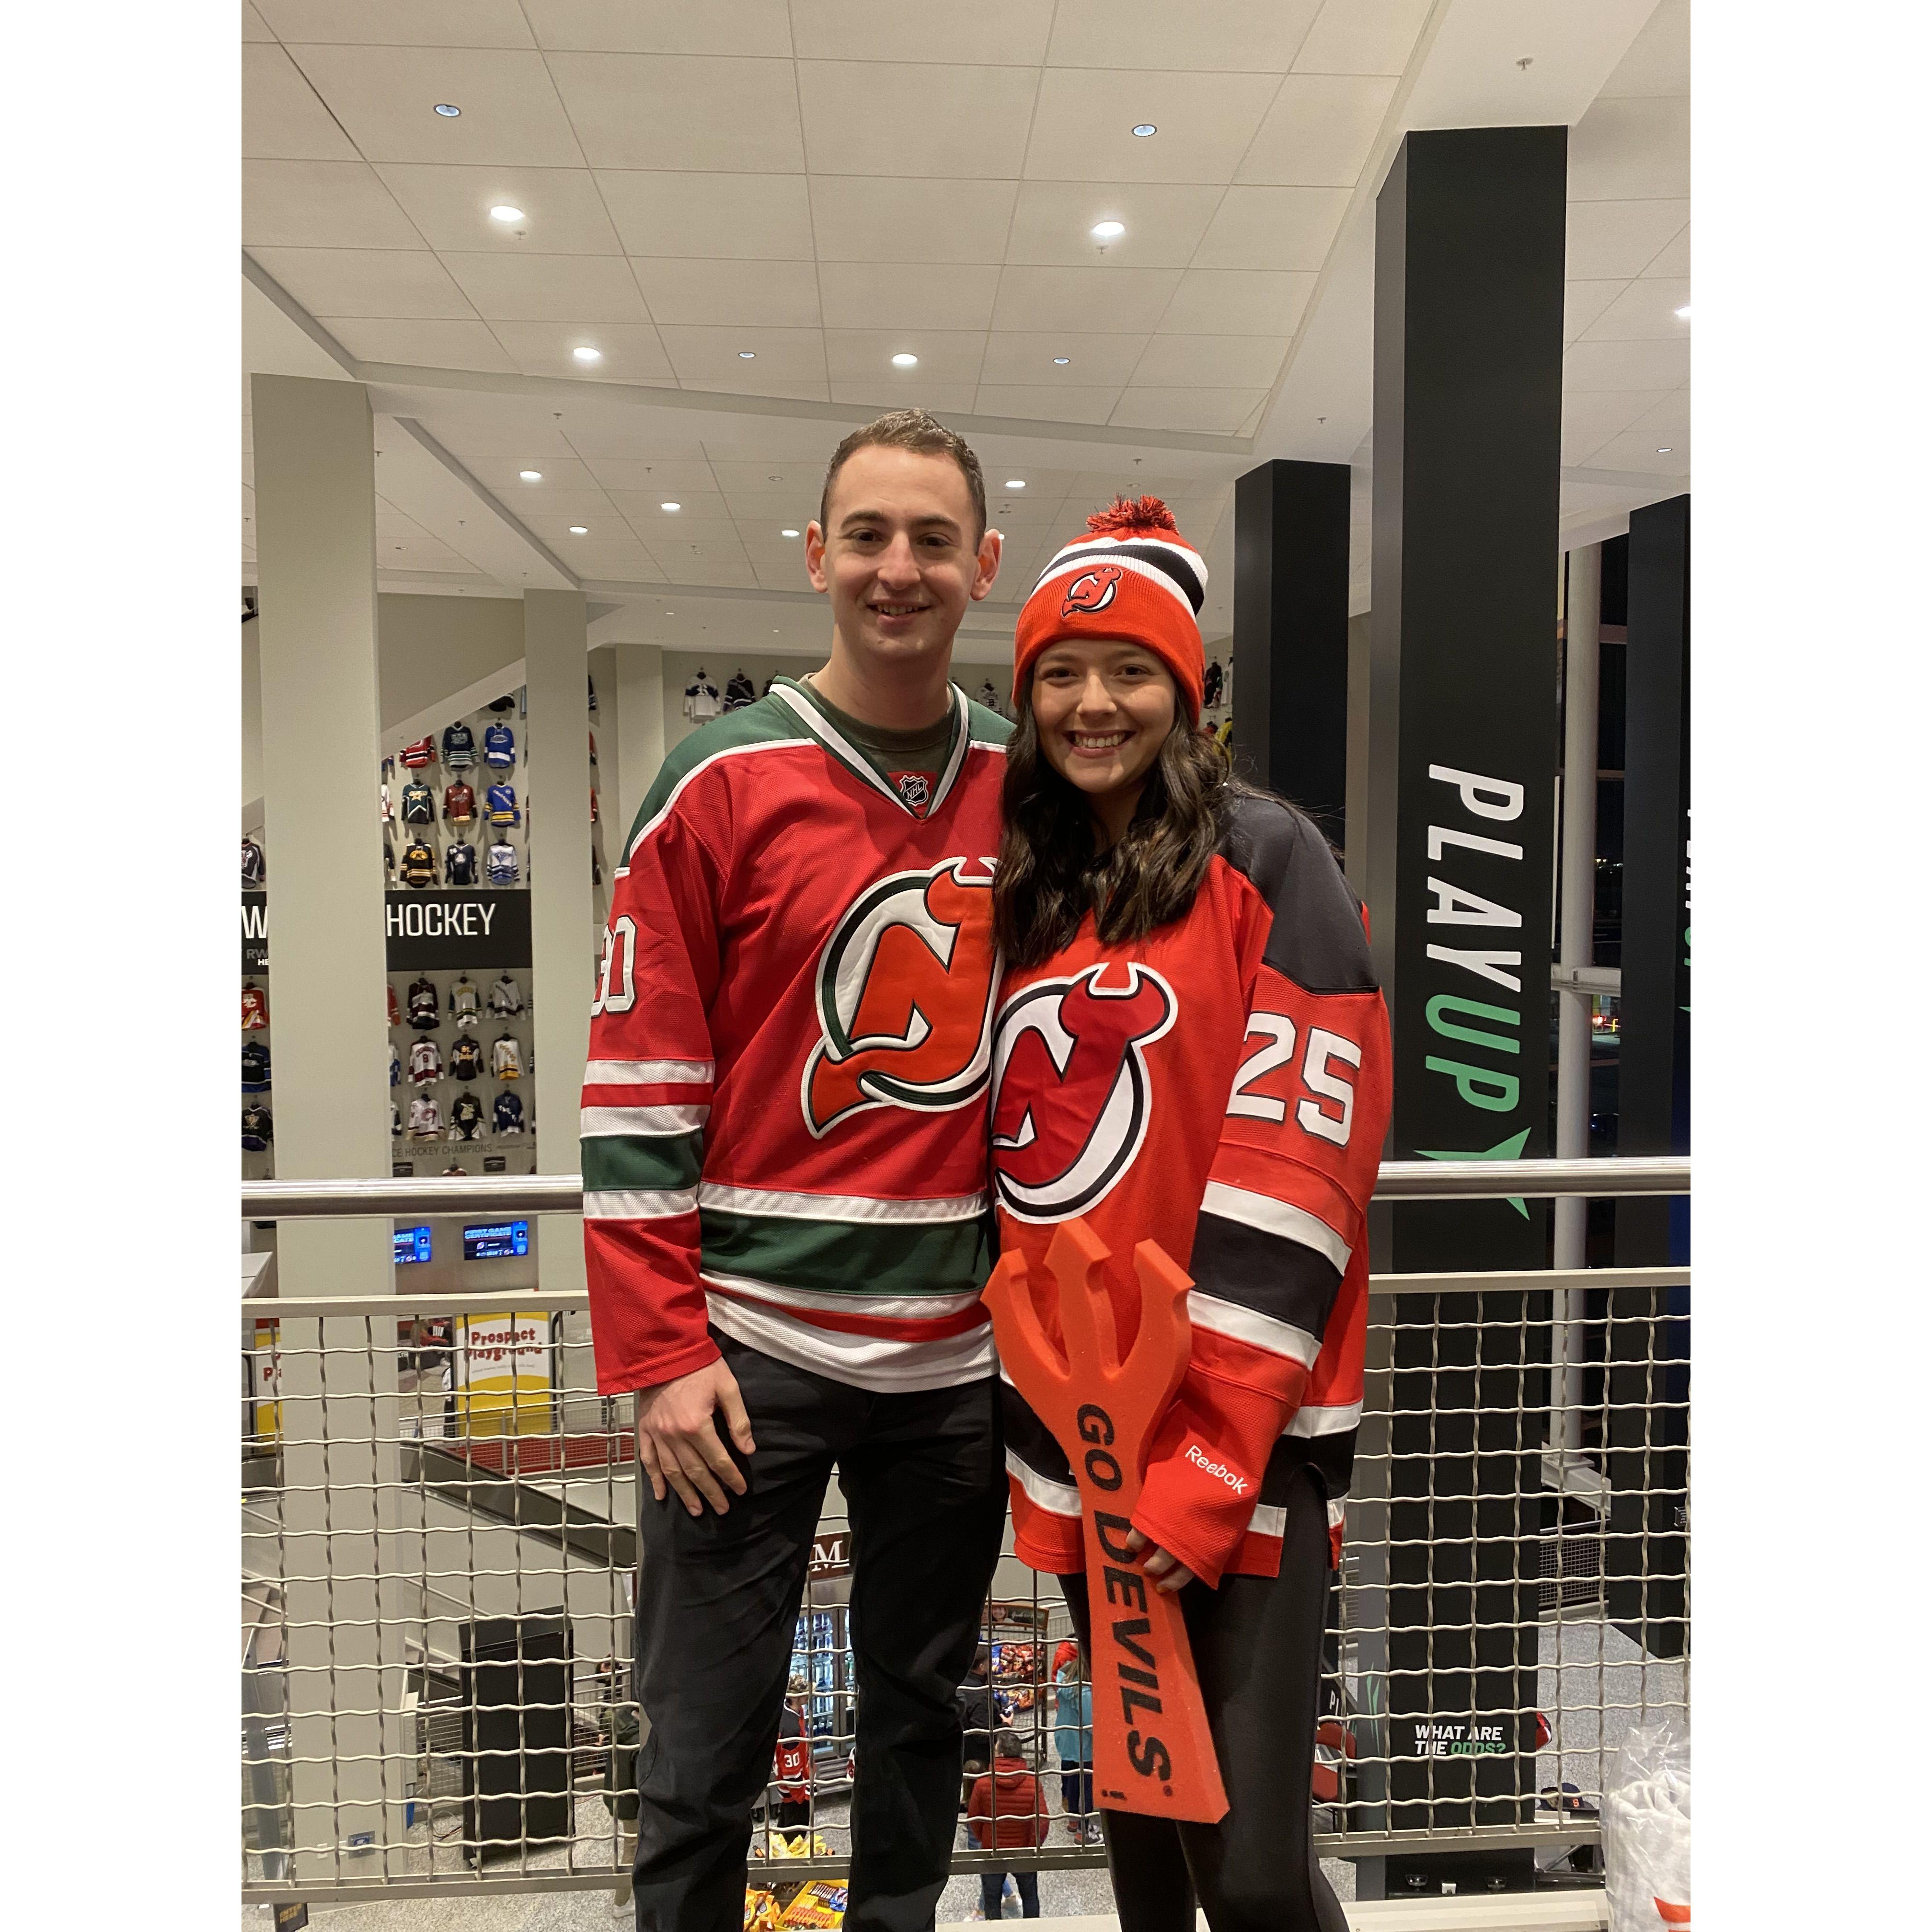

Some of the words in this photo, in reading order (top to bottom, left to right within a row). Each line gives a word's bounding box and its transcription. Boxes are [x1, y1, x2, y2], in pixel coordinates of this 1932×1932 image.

[906, 783, 922, 800] NHL
[386, 903, 496, 936] HOCKEY
[1426, 764, 1524, 1112] PLAYUP
[1224, 1011, 1362, 1149] 25
[405, 1146, 439, 1156] HOCKEY
[442, 1143, 492, 1155] CHAMPIONS
[1077, 1403, 1123, 1492] GO
[1184, 1445, 1249, 1495] Reebok
[1094, 1510, 1172, 1782] DEVILS
[1415, 1725, 1465, 1740] WHAT
[1467, 1726, 1504, 1741] ARE
[1450, 1741, 1506, 1755] ODDS?
[783, 1752, 800, 1768] 30
